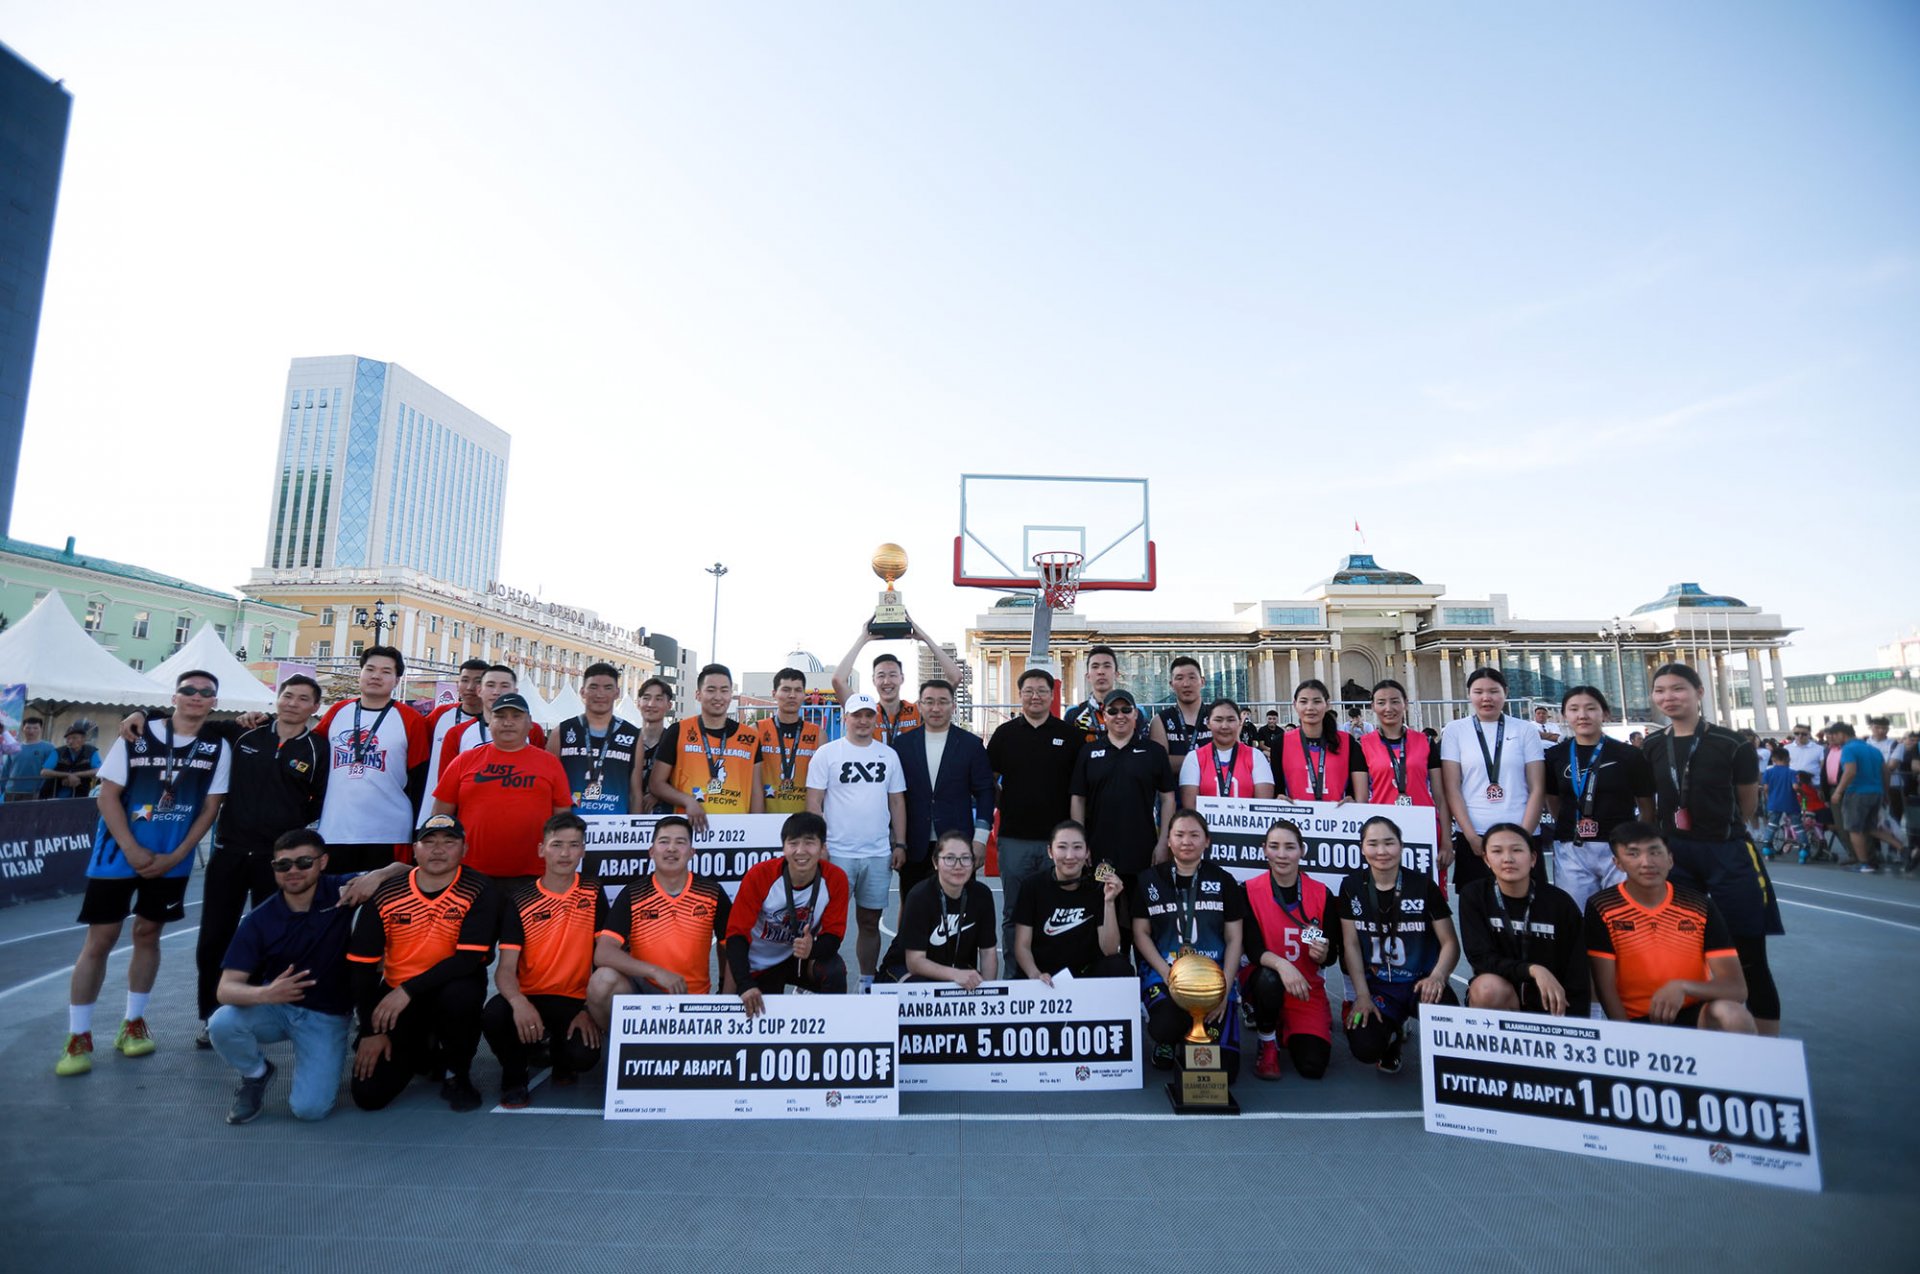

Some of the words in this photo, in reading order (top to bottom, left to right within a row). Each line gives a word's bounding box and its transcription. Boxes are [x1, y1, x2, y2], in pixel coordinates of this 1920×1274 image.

[1837, 673, 1862, 683] LITTLE
[1865, 669, 1893, 680] SHEEP
[484, 763, 515, 776] JUST
[839, 761, 886, 783] 3X3
[501, 775, 522, 788] DO
[523, 775, 536, 788] IT
[581, 801, 615, 811] РЕСУРС
[707, 796, 737, 806] РЕСУРС
[152, 813, 187, 822] РЕСУРС
[1315, 819, 1338, 832] CUP
[1342, 820, 1363, 833] 202
[694, 830, 715, 843] CUP
[719, 829, 745, 842] 2022
[34, 834, 91, 857] ДАРГЫН
[1210, 844, 1236, 860] ДЭД
[2, 858, 44, 878] ГАЗАР
[599, 858, 656, 877] АВАРГА
[1195, 901, 1223, 911] EAGUE
[1051, 907, 1085, 923] NIKE
[1284, 927, 1300, 962] 5
[1371, 936, 1406, 967] 19
[898, 1001, 976, 1018] AANBAATAR
[981, 1001, 1005, 1016] 3x3
[1010, 1000, 1035, 1015] CUP
[1040, 998, 1073, 1014] 2022
[622, 1018, 722, 1035] ULAANBAATAR
[728, 1018, 753, 1035] 3x3
[758, 1018, 785, 1035] CUP
[791, 1018, 826, 1035] 2022
[1431, 1015, 1454, 1023] BOARDING
[1552, 1026, 1562, 1034] CUP
[1578, 1029, 1596, 1038] PLACE
[900, 1032, 968, 1054] АВАРГА
[1433, 1029, 1557, 1060] ULAANBAATAR
[1563, 1043, 1597, 1064] 3x3
[1604, 1047, 1640, 1069] CUP
[1648, 1052, 1698, 1076] 2022
[625, 1060, 680, 1076] ГУТГААР
[683, 1059, 732, 1076] АВАРГА
[736, 1047, 891, 1082] 1.000.000₮
[1442, 1072, 1508, 1098] ГУТГААР
[1512, 1080, 1575, 1107] АВАРГА
[1578, 1079, 1802, 1144] 1.000.000₮
